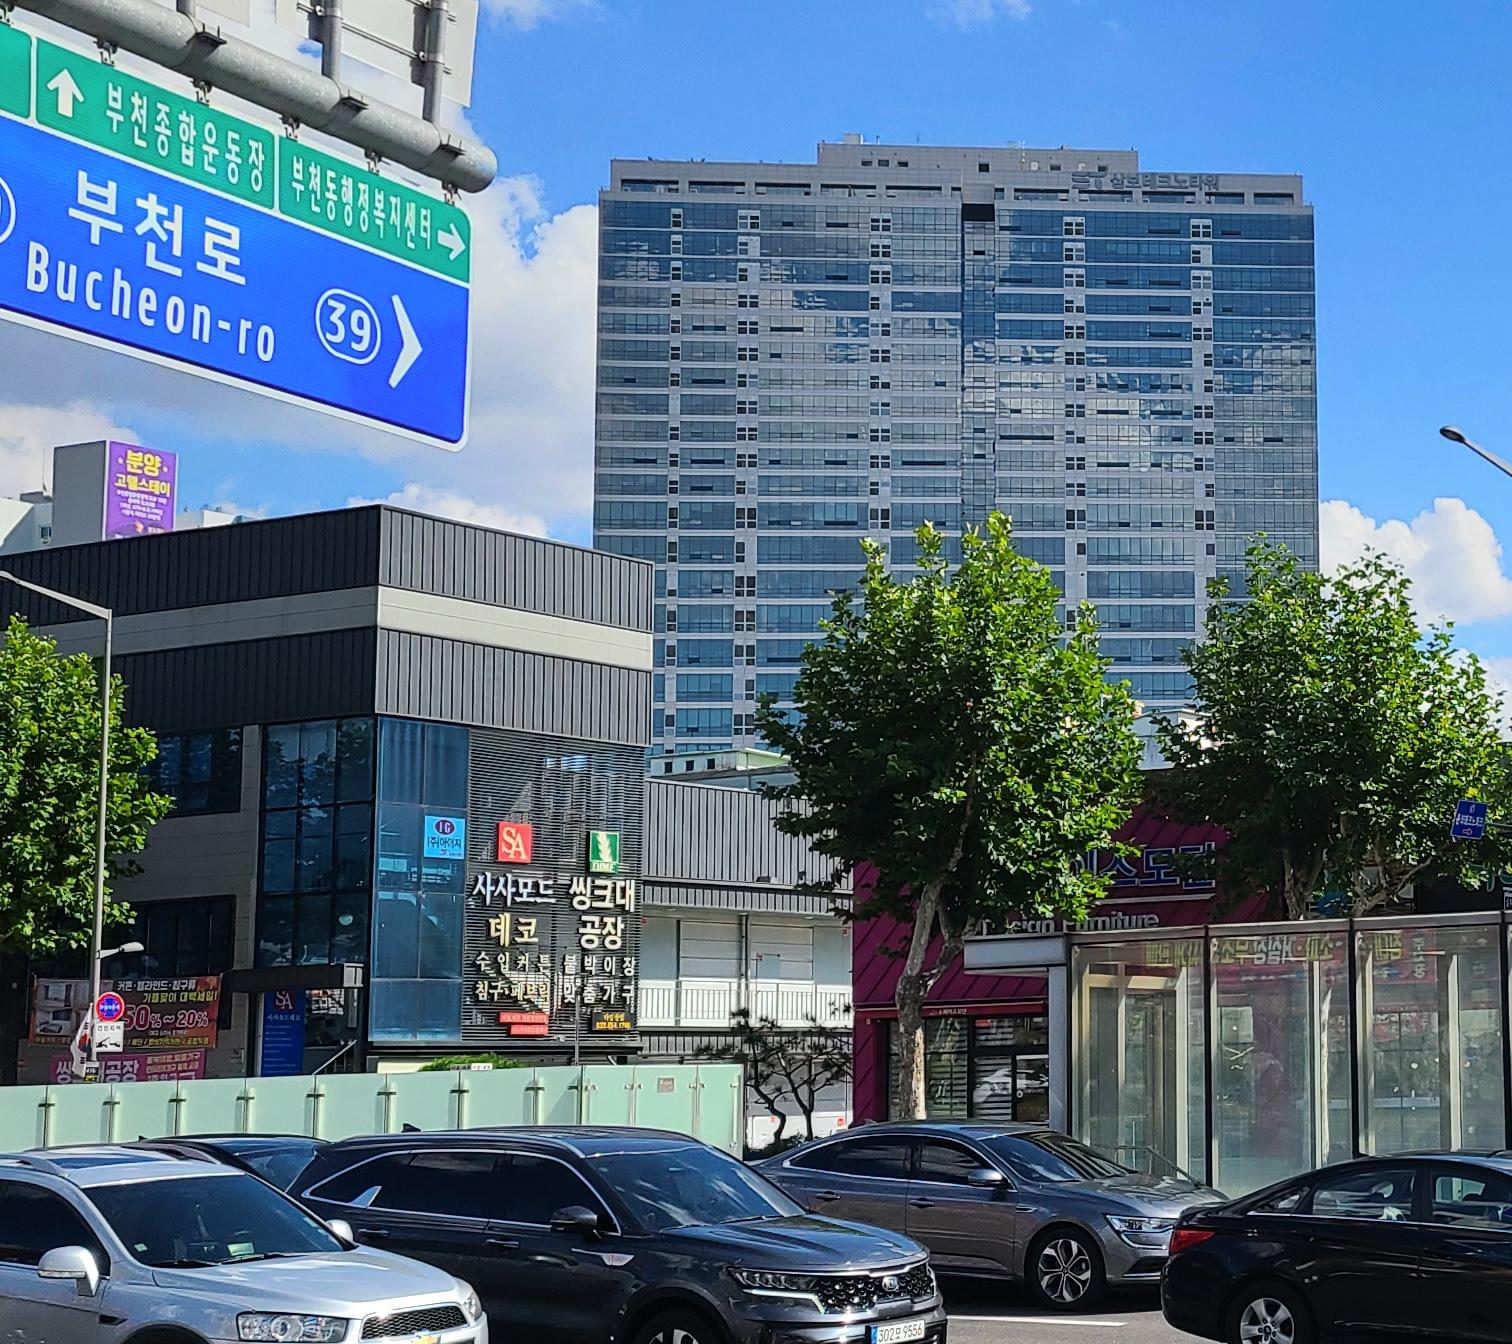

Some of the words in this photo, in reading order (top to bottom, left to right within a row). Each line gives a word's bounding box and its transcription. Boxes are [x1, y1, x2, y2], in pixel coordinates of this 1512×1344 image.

[106, 82, 264, 192] 부천종합운동장
[292, 155, 431, 249] 부천동행정복지센터
[68, 170, 246, 285] 부천로
[26, 240, 274, 361] Bucheon-ro
[325, 298, 371, 351] 39
[126, 449, 162, 477] 분양
[502, 826, 527, 860] SA
[473, 872, 557, 907] 사사모드
[570, 876, 636, 913] 씽크대
[489, 913, 539, 947] 데코
[579, 915, 625, 949] 공장
[176, 1009, 209, 1028] 20%
